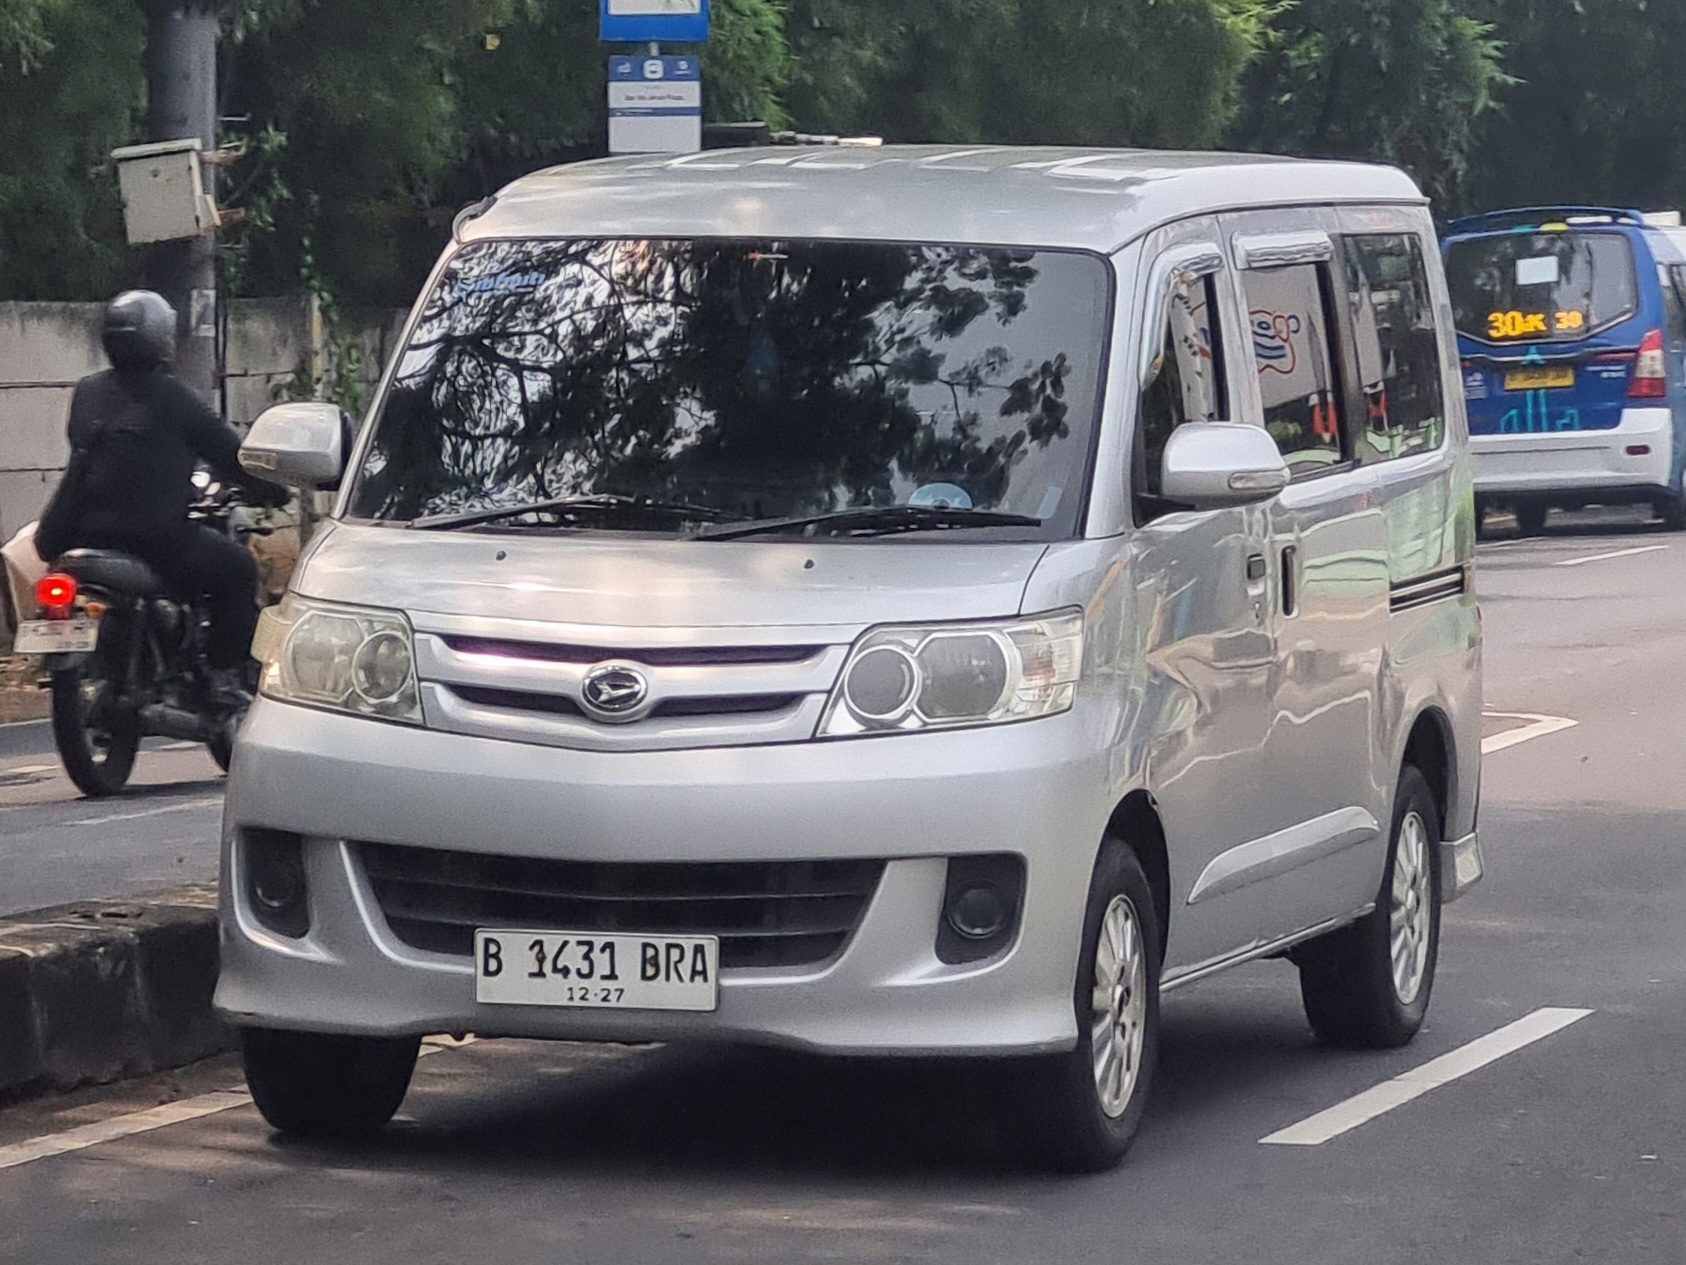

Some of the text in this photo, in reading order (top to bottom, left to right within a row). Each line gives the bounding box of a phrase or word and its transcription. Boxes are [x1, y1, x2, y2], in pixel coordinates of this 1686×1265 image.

[482, 937, 709, 983] B 1431 BRA
